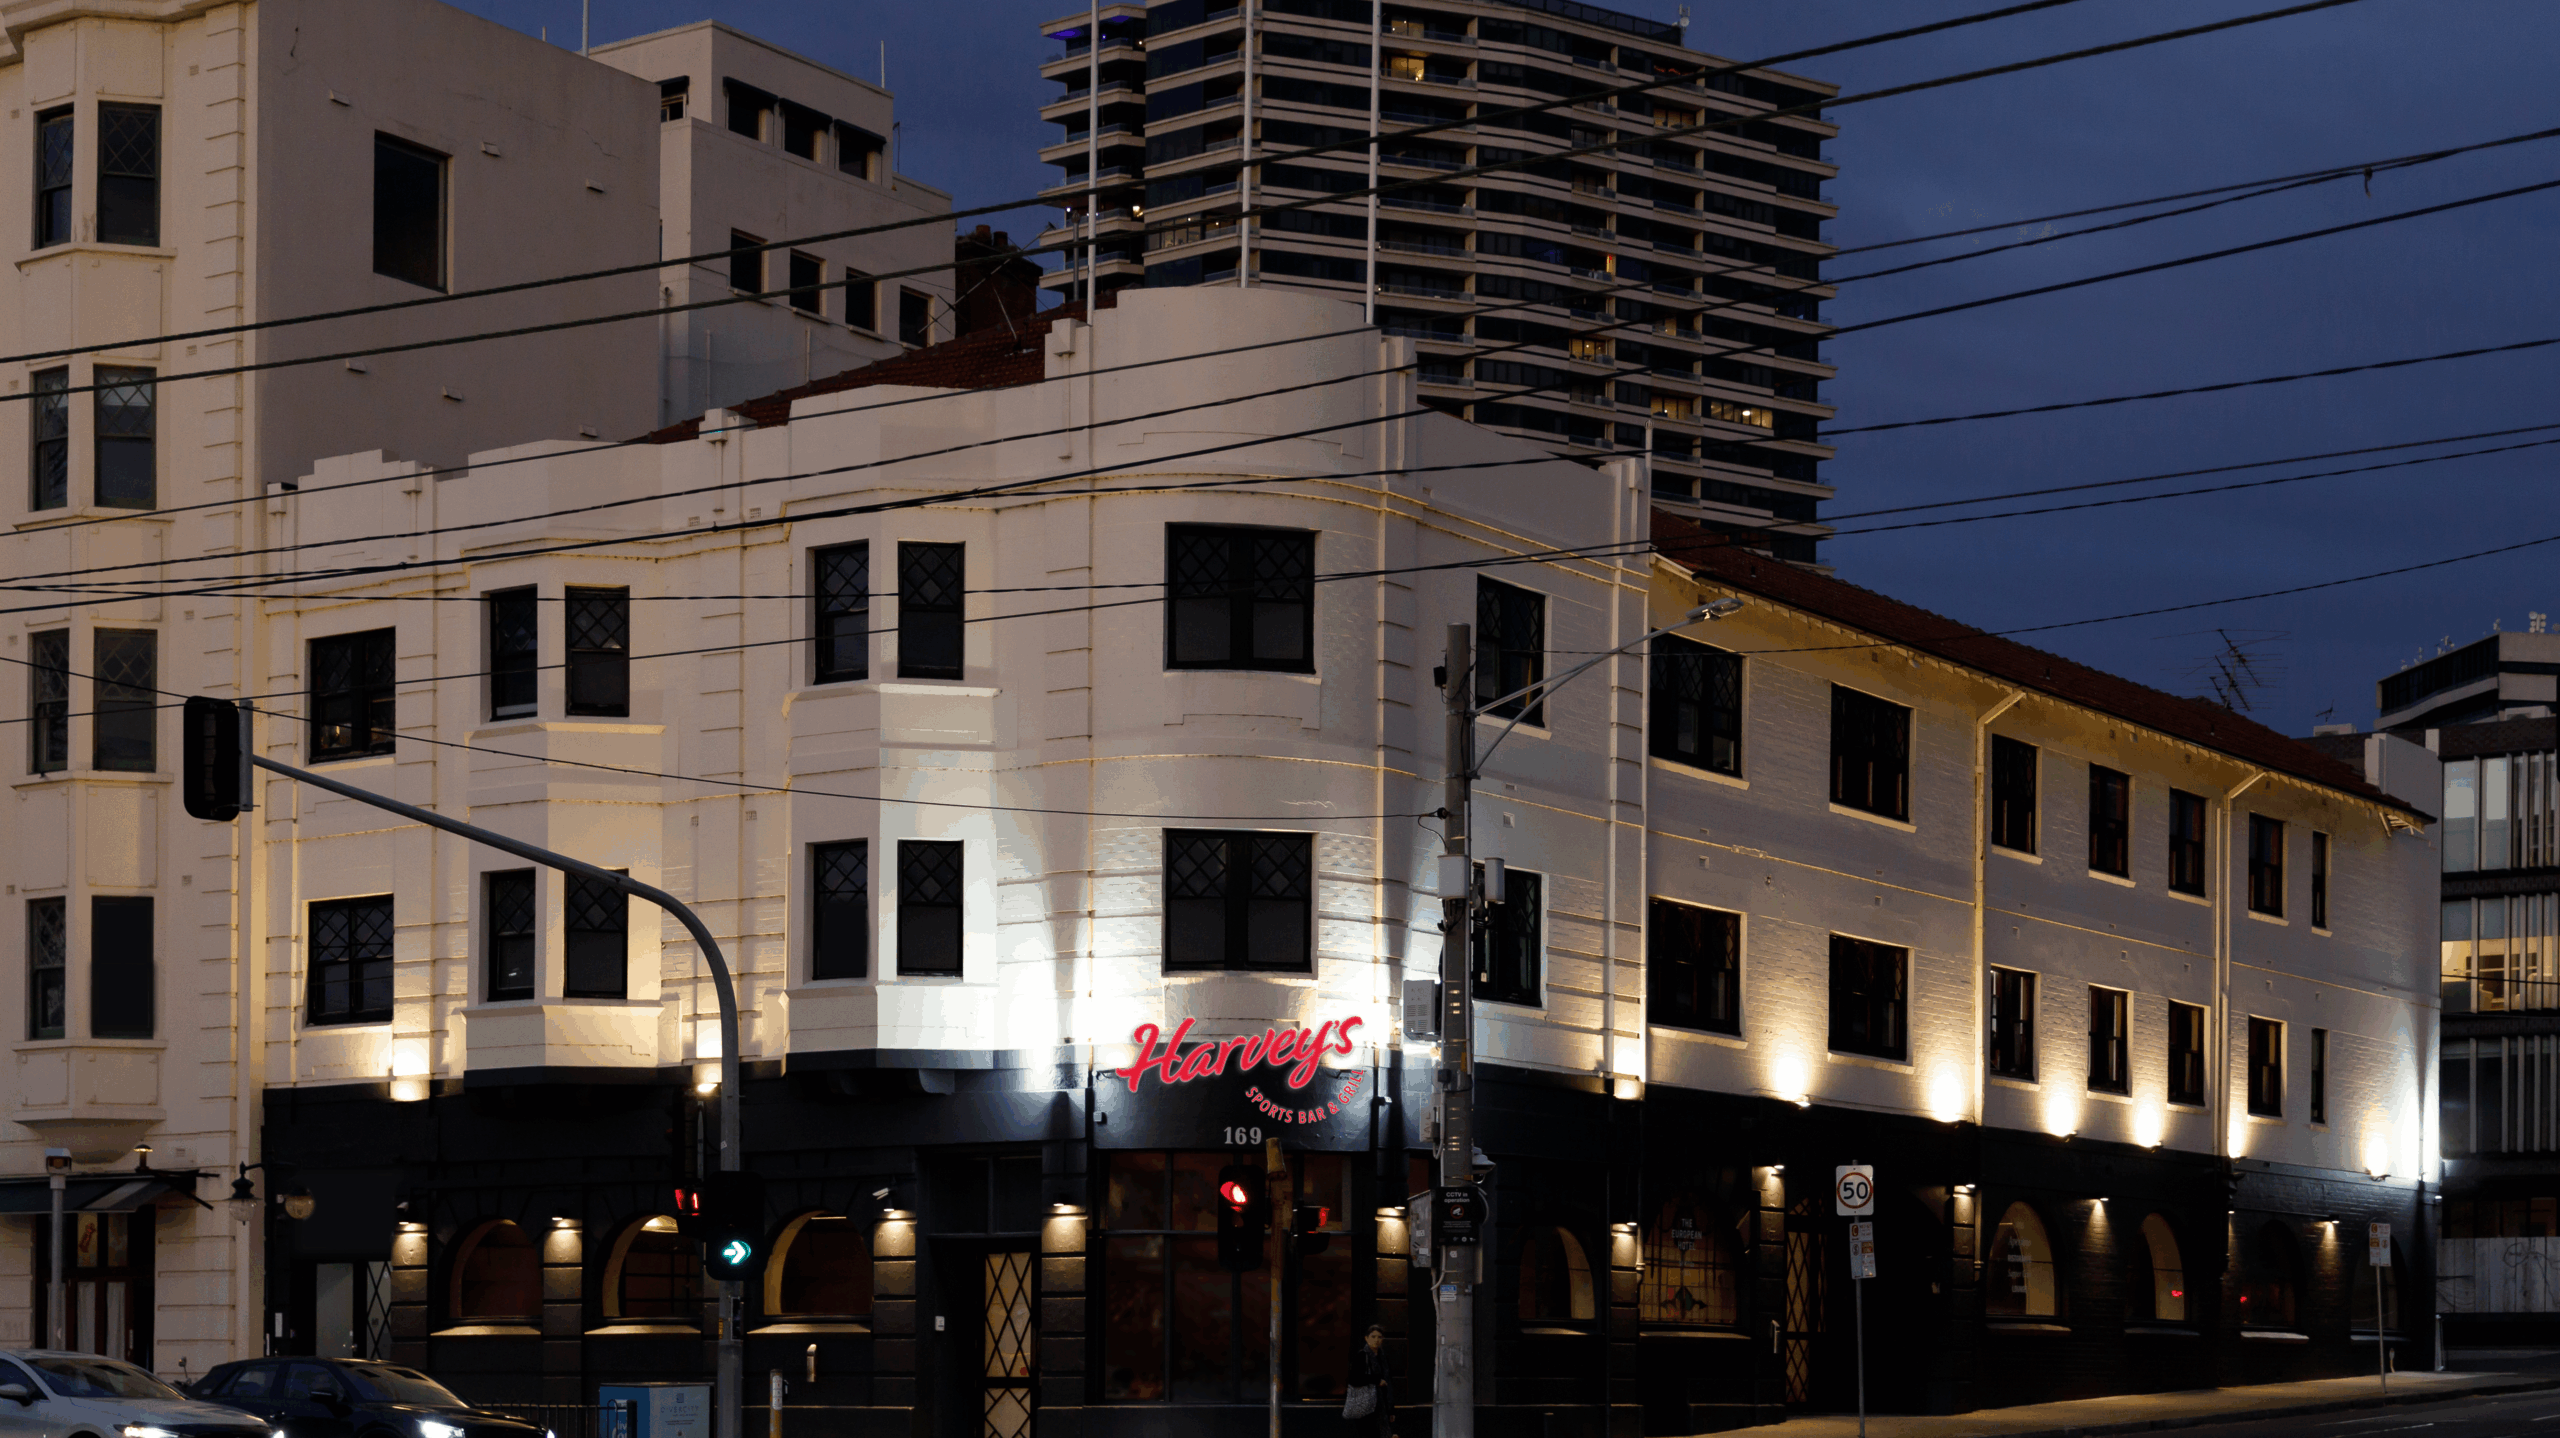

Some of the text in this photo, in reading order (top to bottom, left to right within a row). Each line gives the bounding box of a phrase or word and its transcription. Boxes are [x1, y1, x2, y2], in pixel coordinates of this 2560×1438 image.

[1115, 1015, 1363, 1092] Harvey's
[1245, 1069, 1364, 1124] SPORTS BAR & GRILL
[1223, 1126, 1262, 1145] 169
[1843, 1181, 1868, 1200] 50
[1681, 1218, 1693, 1228] THE
[1672, 1229, 1702, 1240] EUROPEAN
[1678, 1241, 1696, 1250] HOTEL
